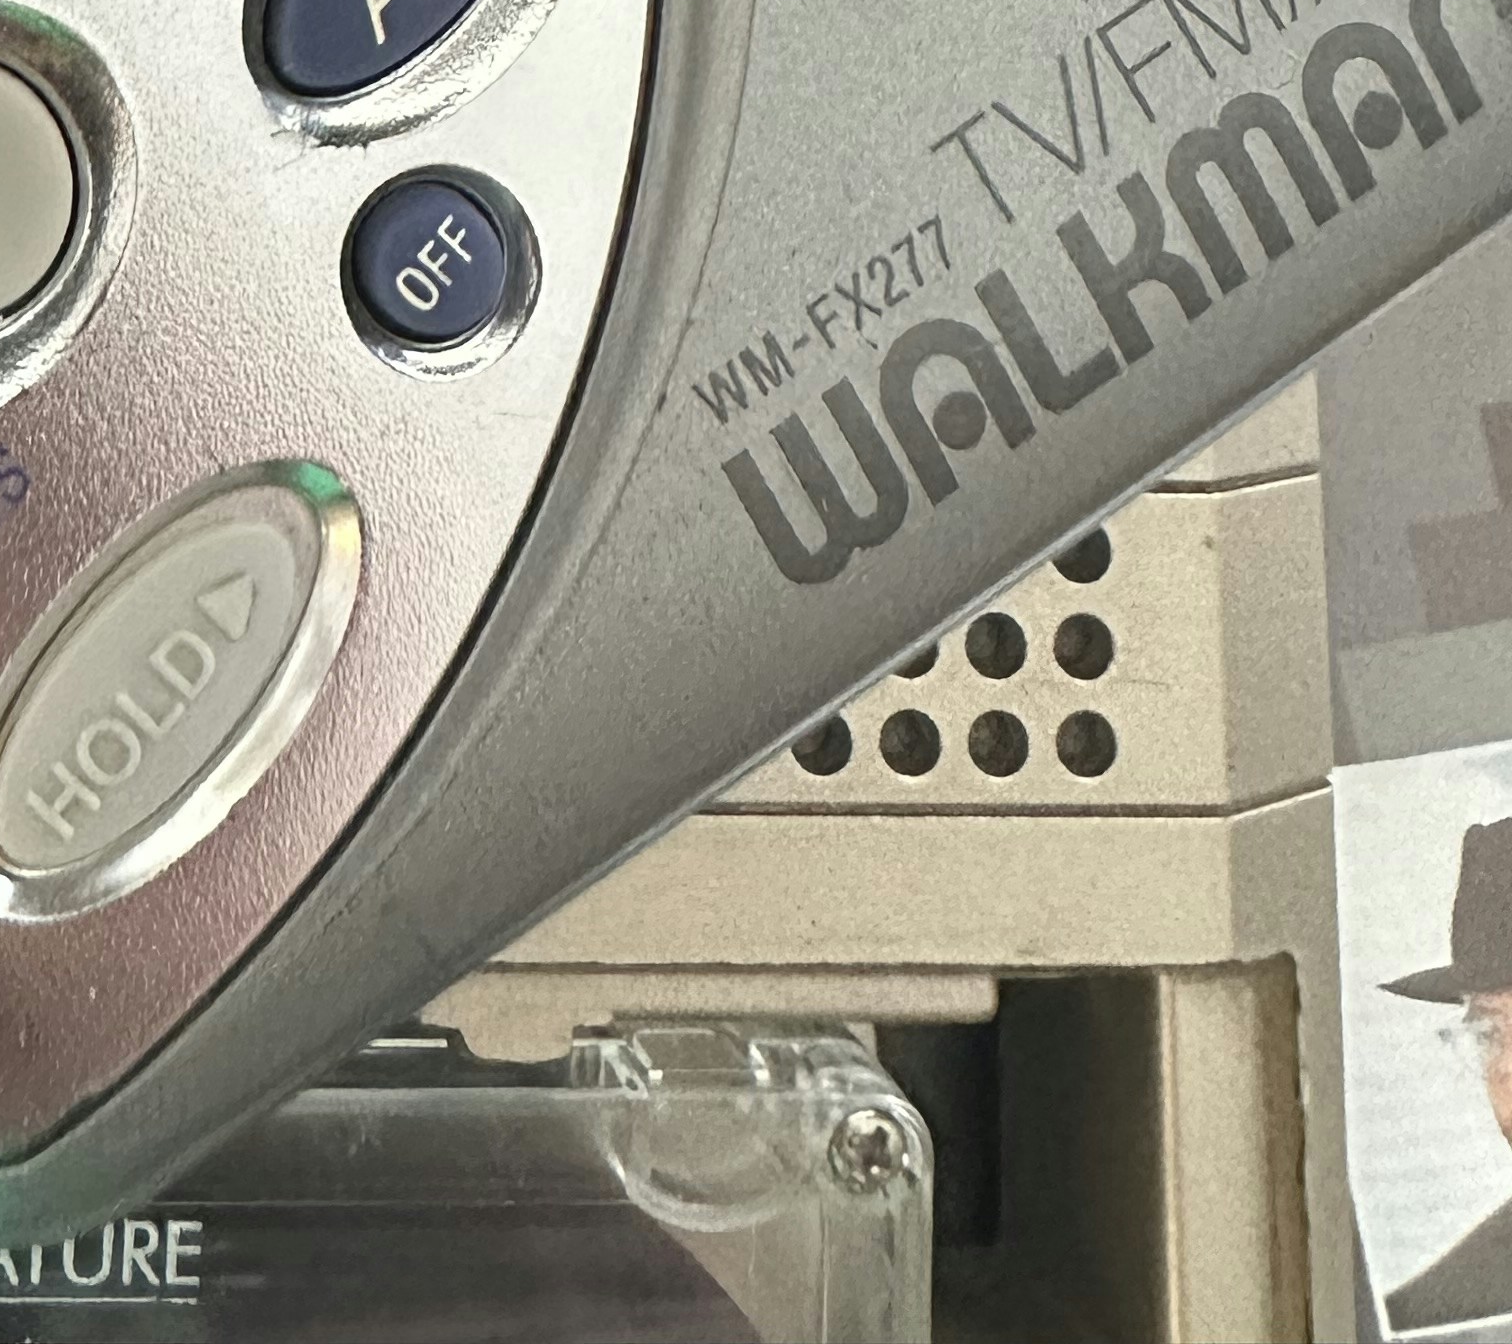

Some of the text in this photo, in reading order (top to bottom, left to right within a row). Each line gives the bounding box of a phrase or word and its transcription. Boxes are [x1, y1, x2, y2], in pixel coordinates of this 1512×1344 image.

[395, 213, 472, 311] OFF
[691, 214, 951, 425] WM-FX277
[27, 629, 216, 841] HOLD
